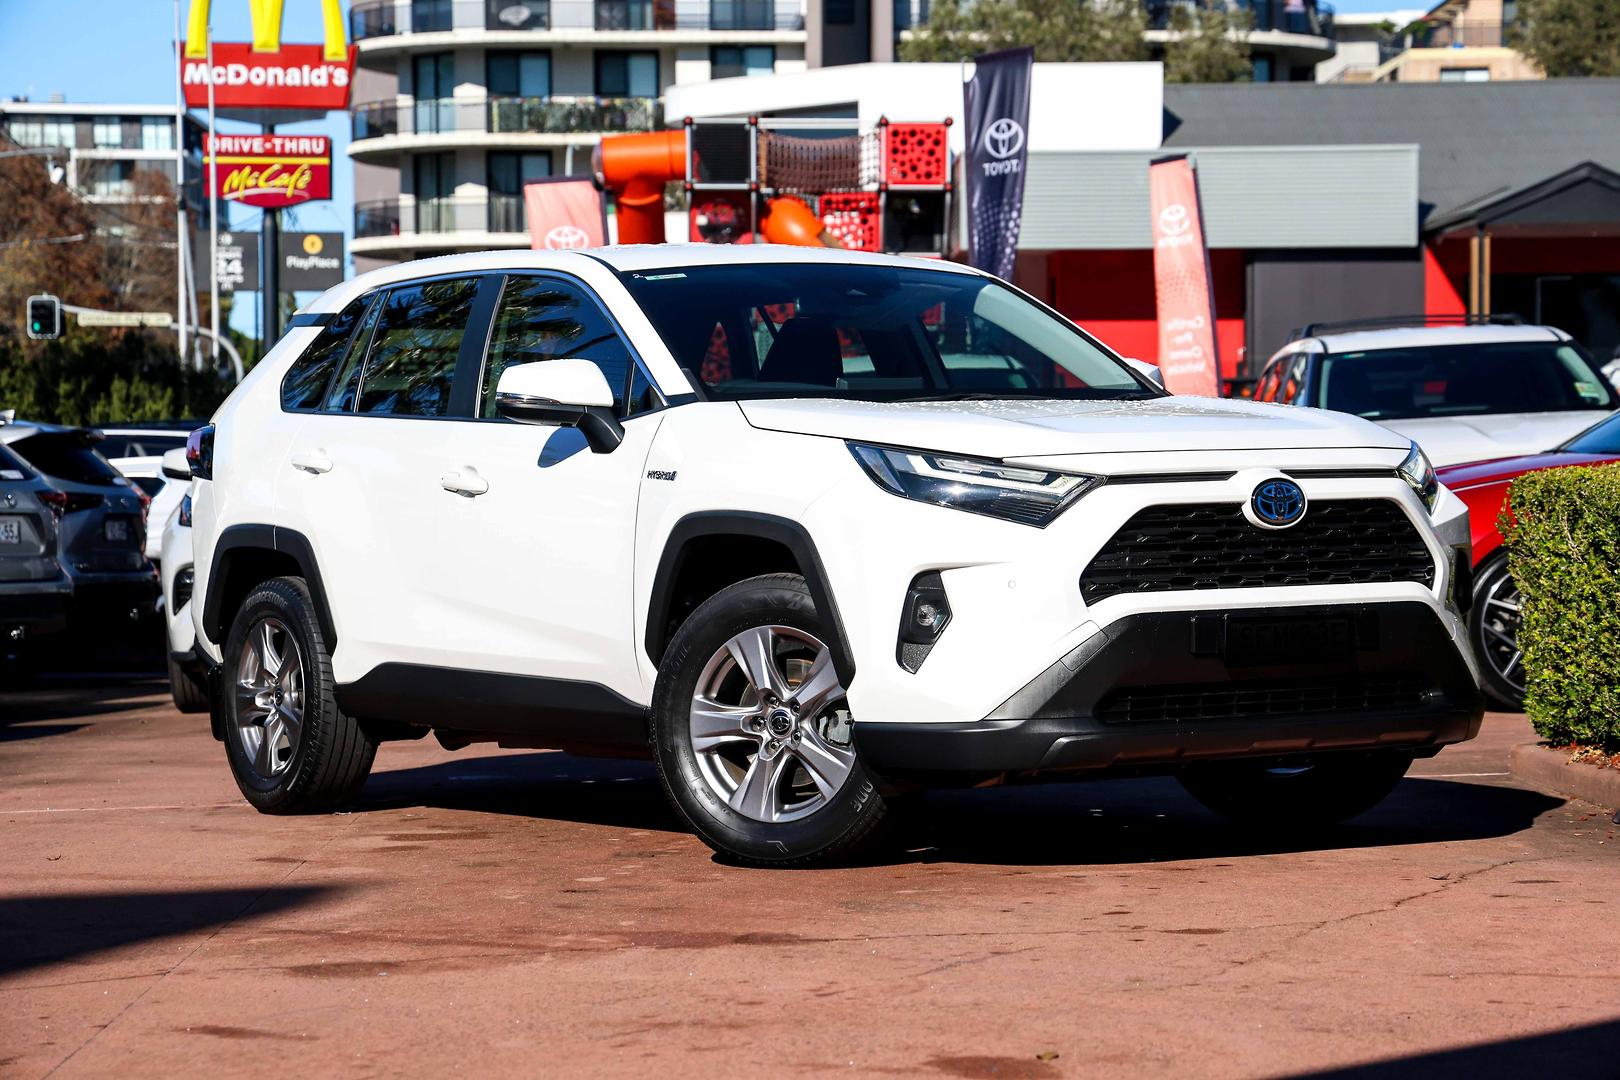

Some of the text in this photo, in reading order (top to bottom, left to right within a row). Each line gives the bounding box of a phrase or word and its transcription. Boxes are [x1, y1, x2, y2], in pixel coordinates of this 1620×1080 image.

[184, 63, 348, 86] McDonald's
[982, 159, 1020, 177] TOYOT
[286, 255, 340, 270] PlayPlace
